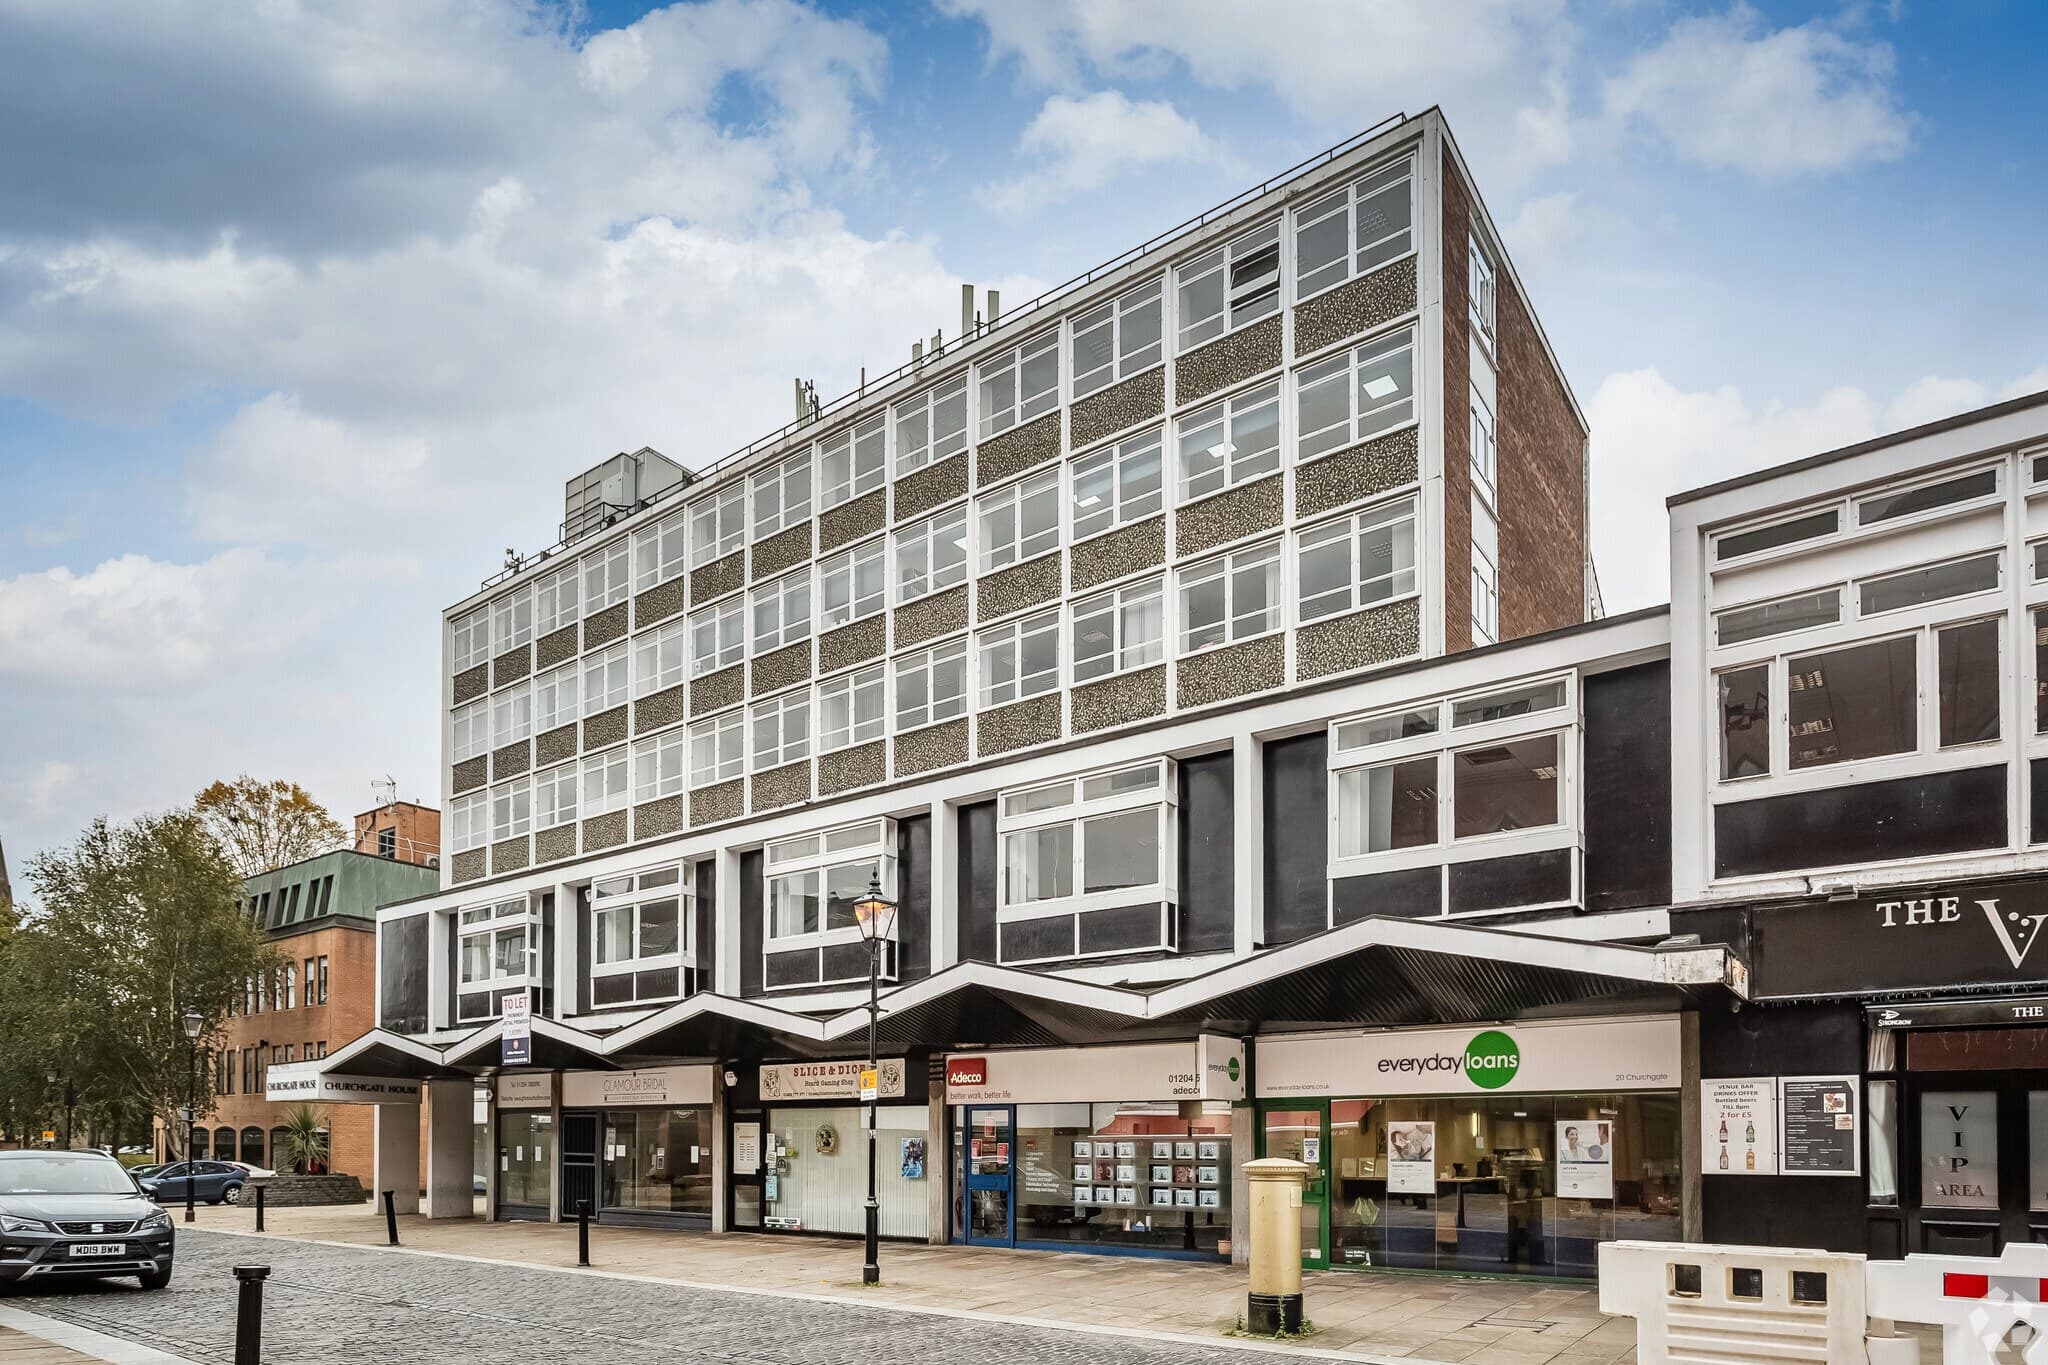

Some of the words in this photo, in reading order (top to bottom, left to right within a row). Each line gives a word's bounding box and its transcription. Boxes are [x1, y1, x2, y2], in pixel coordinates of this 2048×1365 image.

[1876, 897, 1960, 927] THE
[504, 999, 513, 1009] TO
[515, 997, 528, 1008] LET
[2012, 1007, 2044, 1017] THE
[1377, 1053, 1463, 1076] everyday
[1465, 1052, 1518, 1069] loans
[793, 1066, 826, 1077] SLICE
[828, 1067, 836, 1075] &
[1626, 1072, 1668, 1081] Churchgate
[821, 1079, 840, 1087] Gaming
[841, 1078, 854, 1086] Shop
[950, 1072, 982, 1083] Adecco
[1168, 1074, 1193, 1083] 01204
[267, 1080, 298, 1091] CHURCHGATE
[300, 1079, 316, 1088] HOUSE
[324, 1081, 385, 1092] CHURCHGATE
[388, 1085, 417, 1094] HOUSE
[603, 1078, 641, 1092] GLAMOUR
[643, 1077, 667, 1090] BRIDAL
[1935, 1184, 1985, 1197] AREA
[75, 1246, 98, 1255] MD19
